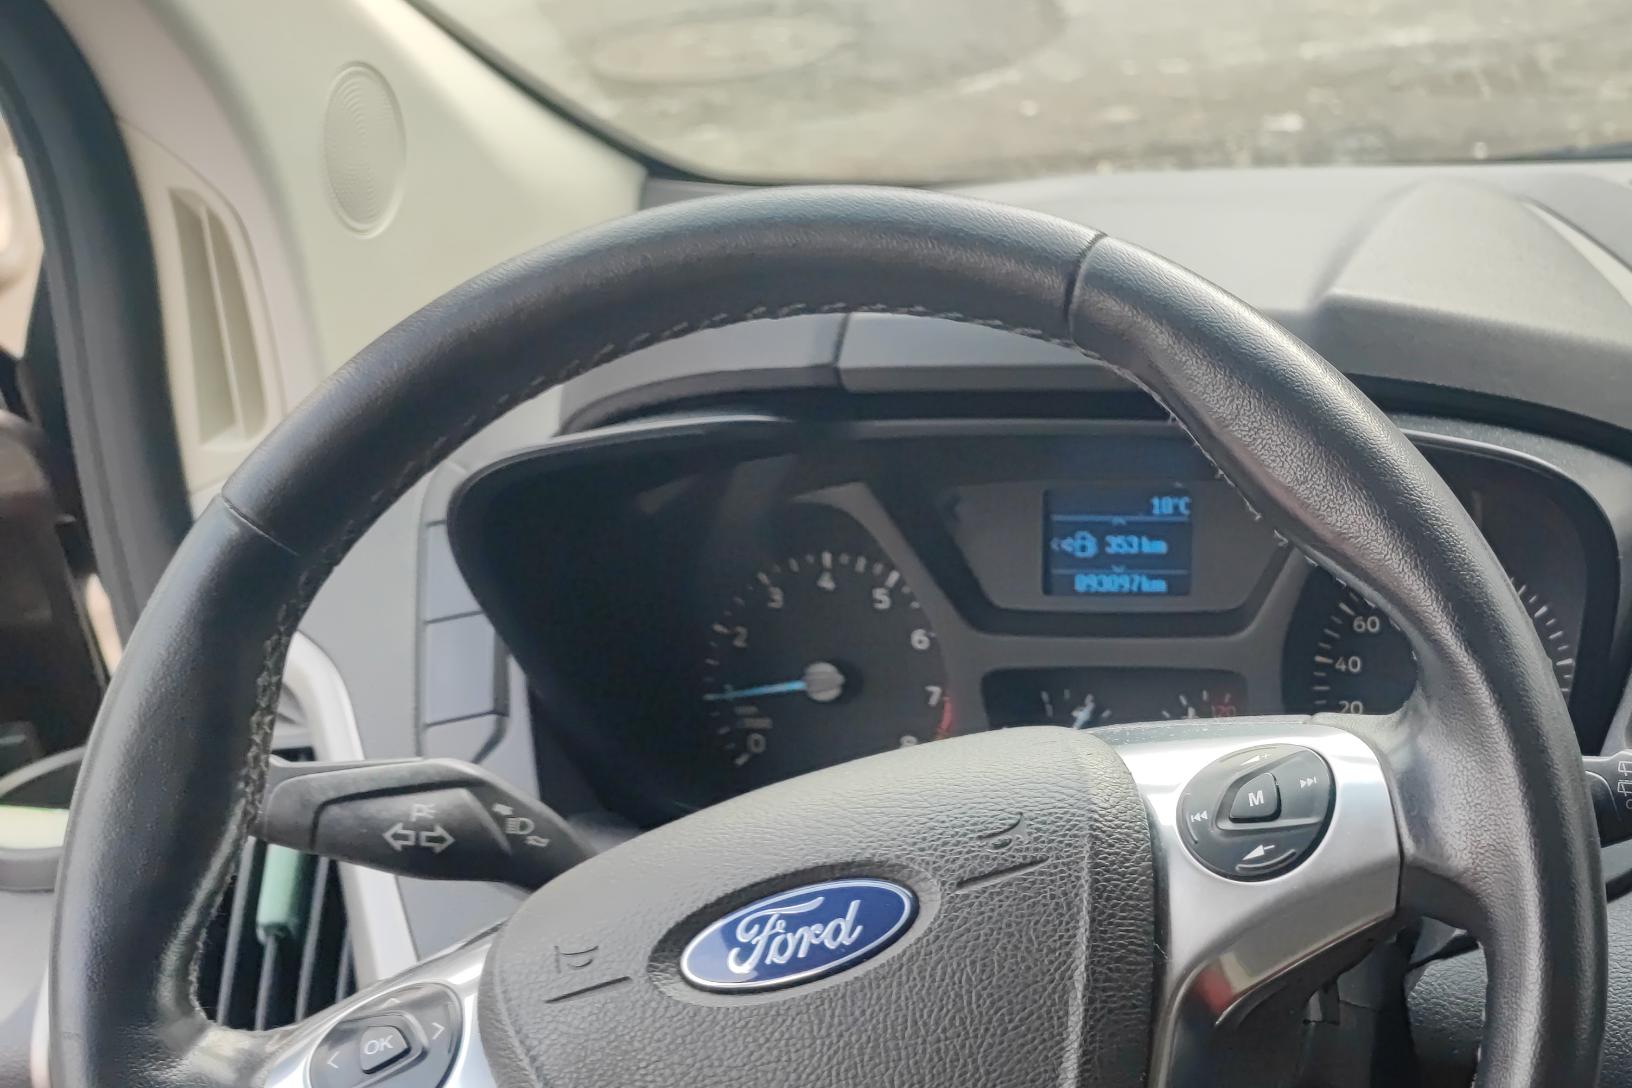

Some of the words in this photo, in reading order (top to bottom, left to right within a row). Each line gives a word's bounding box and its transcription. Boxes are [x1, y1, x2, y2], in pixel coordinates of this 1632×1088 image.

[872, 587, 891, 610] 5
[1353, 616, 1380, 633] 60
[910, 628, 930, 650] 6
[1334, 655, 1362, 673] 40
[925, 685, 942, 706] 7
[1338, 700, 1363, 714] 20
[1247, 789, 1265, 807] M
[727, 896, 864, 974] Ford
[364, 1034, 394, 1055] OK
